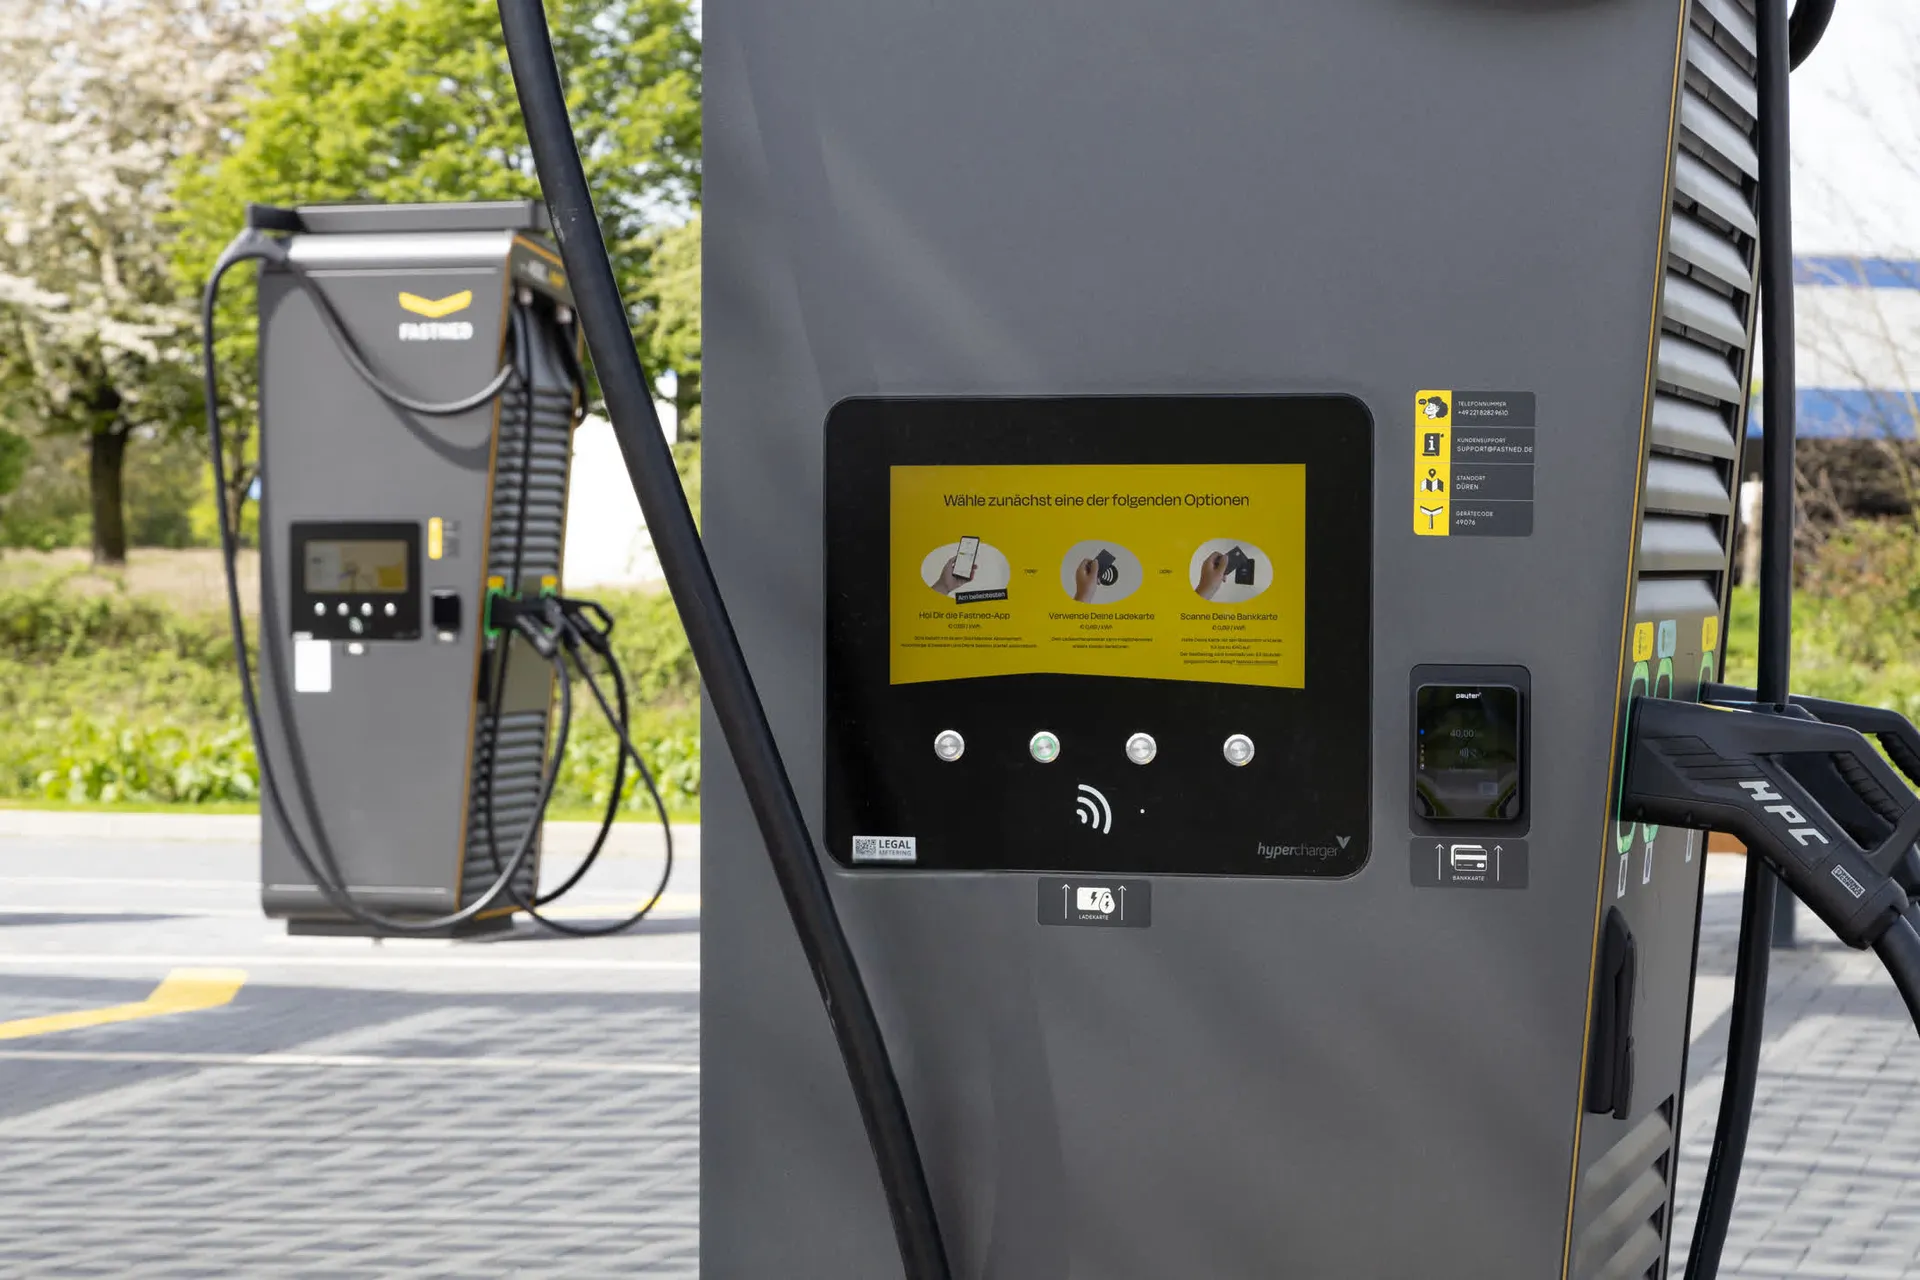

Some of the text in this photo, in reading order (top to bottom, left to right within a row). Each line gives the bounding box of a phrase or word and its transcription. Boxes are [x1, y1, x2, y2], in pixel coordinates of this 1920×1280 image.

[399, 322, 473, 340] FASTNED
[1456, 482, 1479, 490] DÜREN
[943, 494, 1250, 509] Wähle zunächst eine der folgenden Optionen
[1048, 612, 1155, 620] Verwende Deine Ladekarte
[1739, 781, 1830, 846] HPC
[879, 840, 911, 849] LEGAL
[1257, 842, 1338, 860] hypercharger
